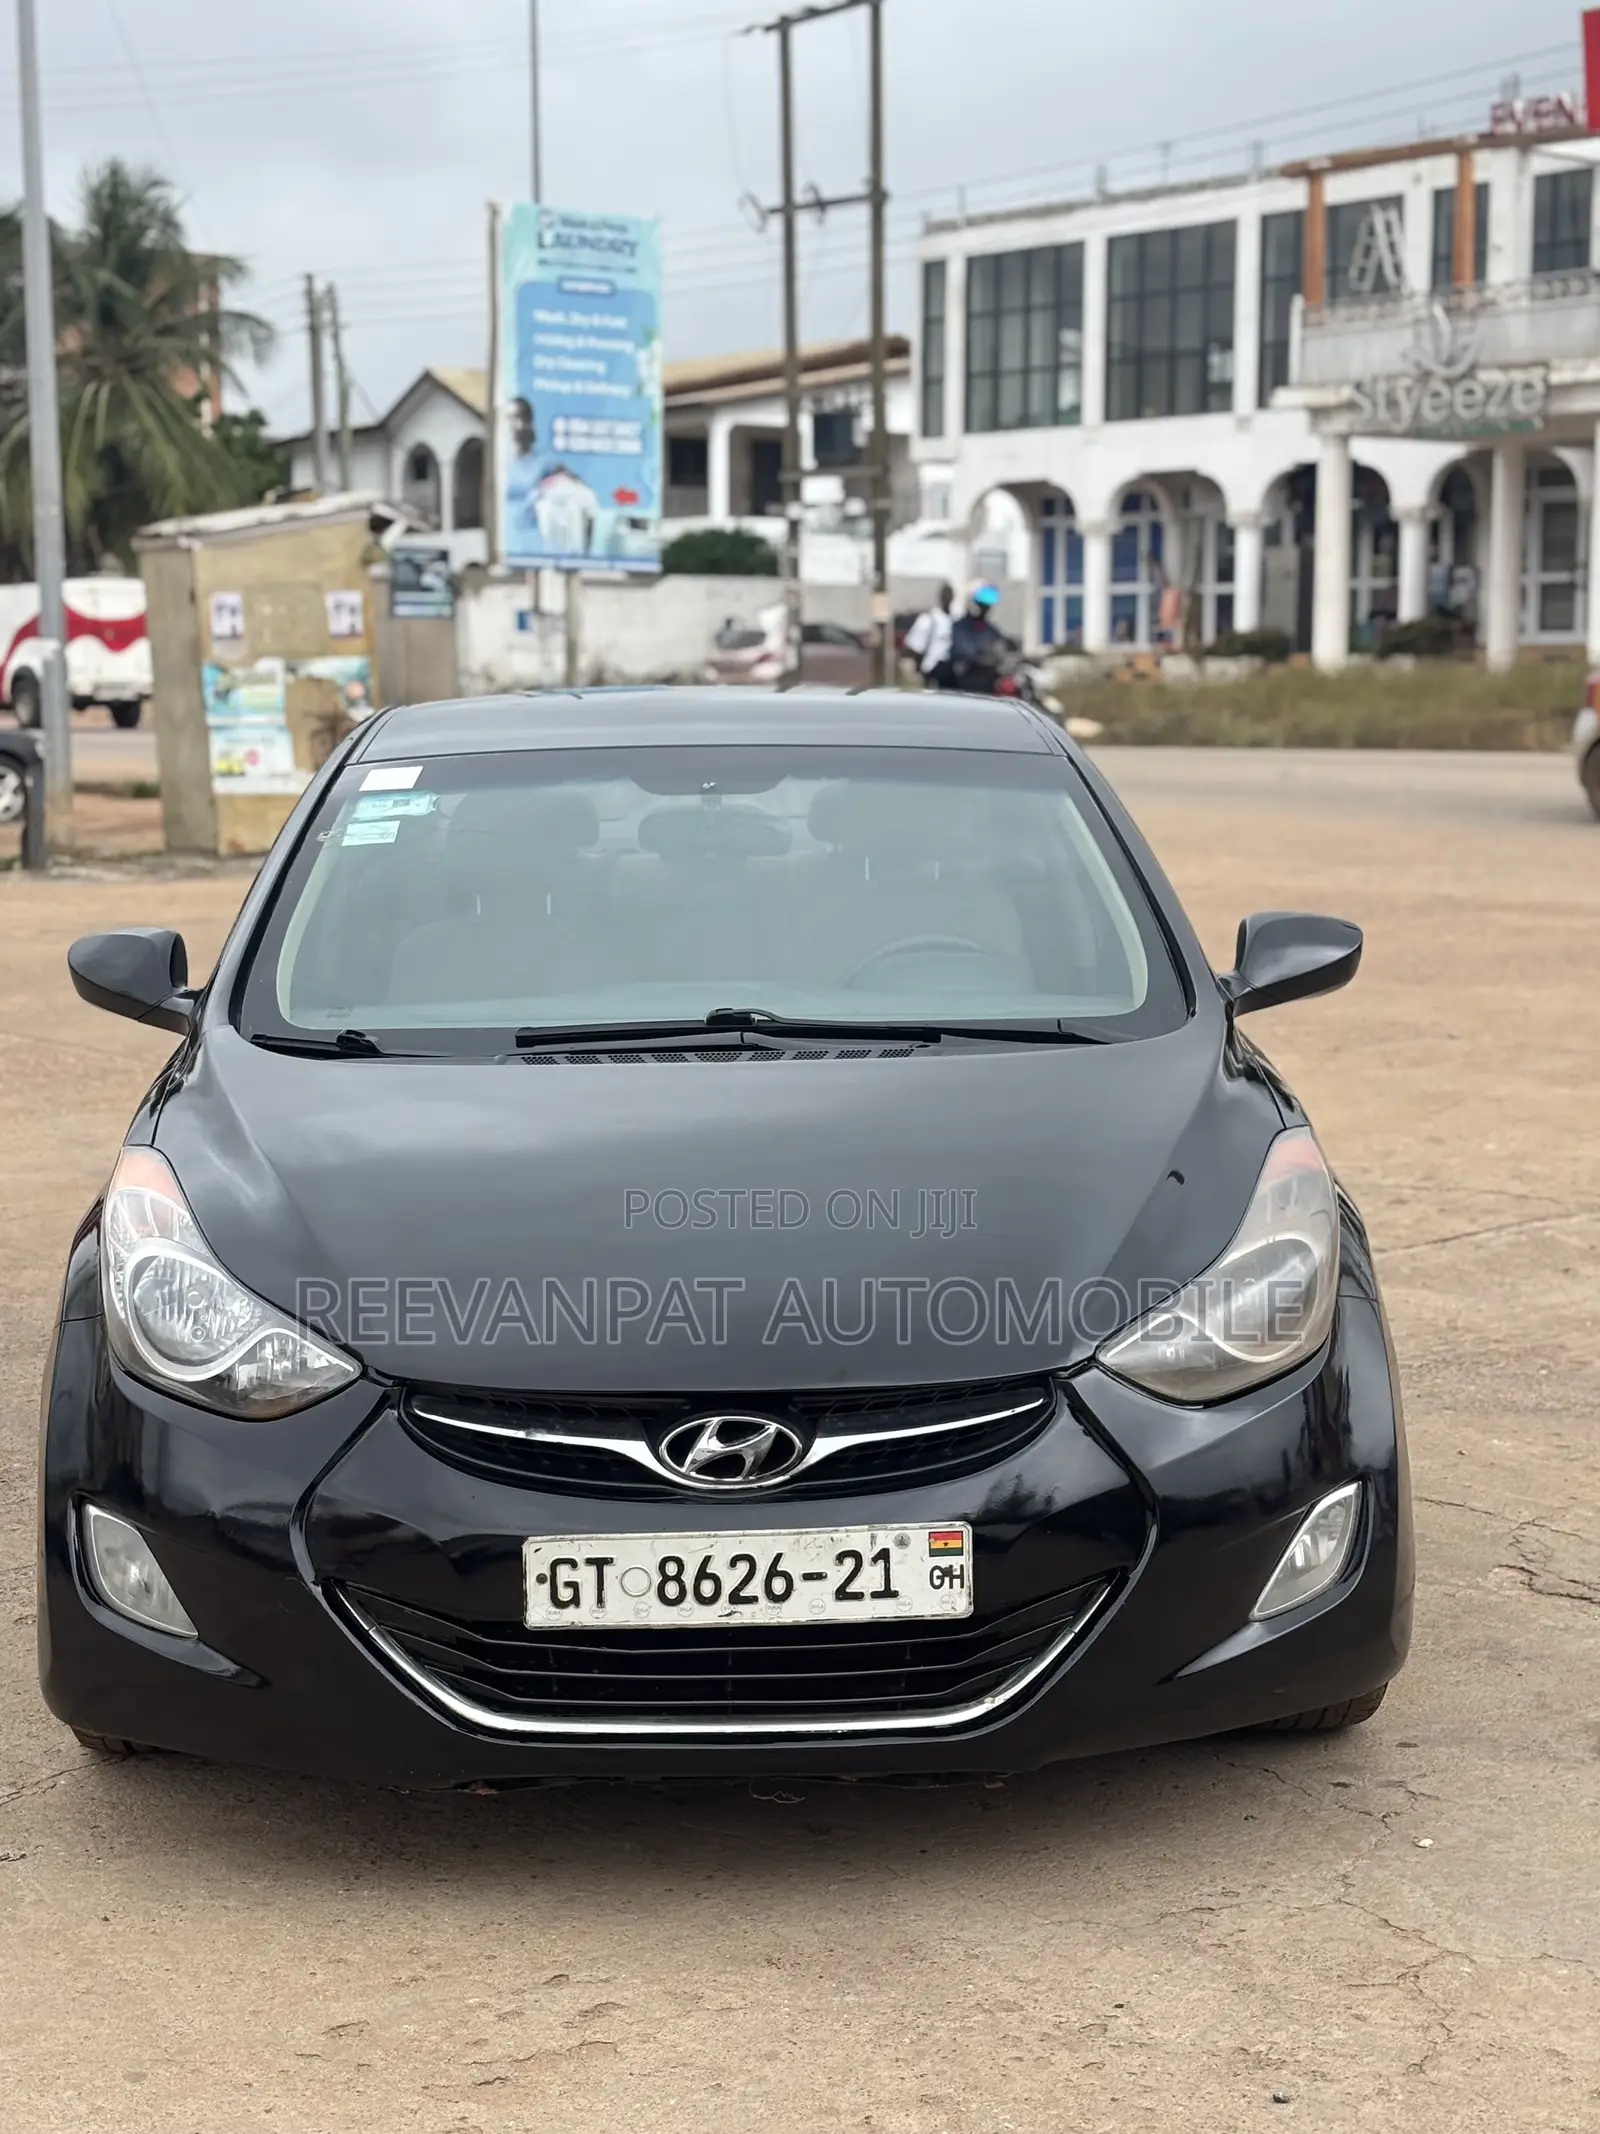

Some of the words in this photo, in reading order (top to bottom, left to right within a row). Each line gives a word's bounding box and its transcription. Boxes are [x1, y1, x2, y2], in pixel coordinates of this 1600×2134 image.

[1491, 93, 1584, 136] EVEN
[549, 1556, 615, 1608] GT
[656, 1547, 899, 1607] 8626-21
[929, 1564, 964, 1590] GH
